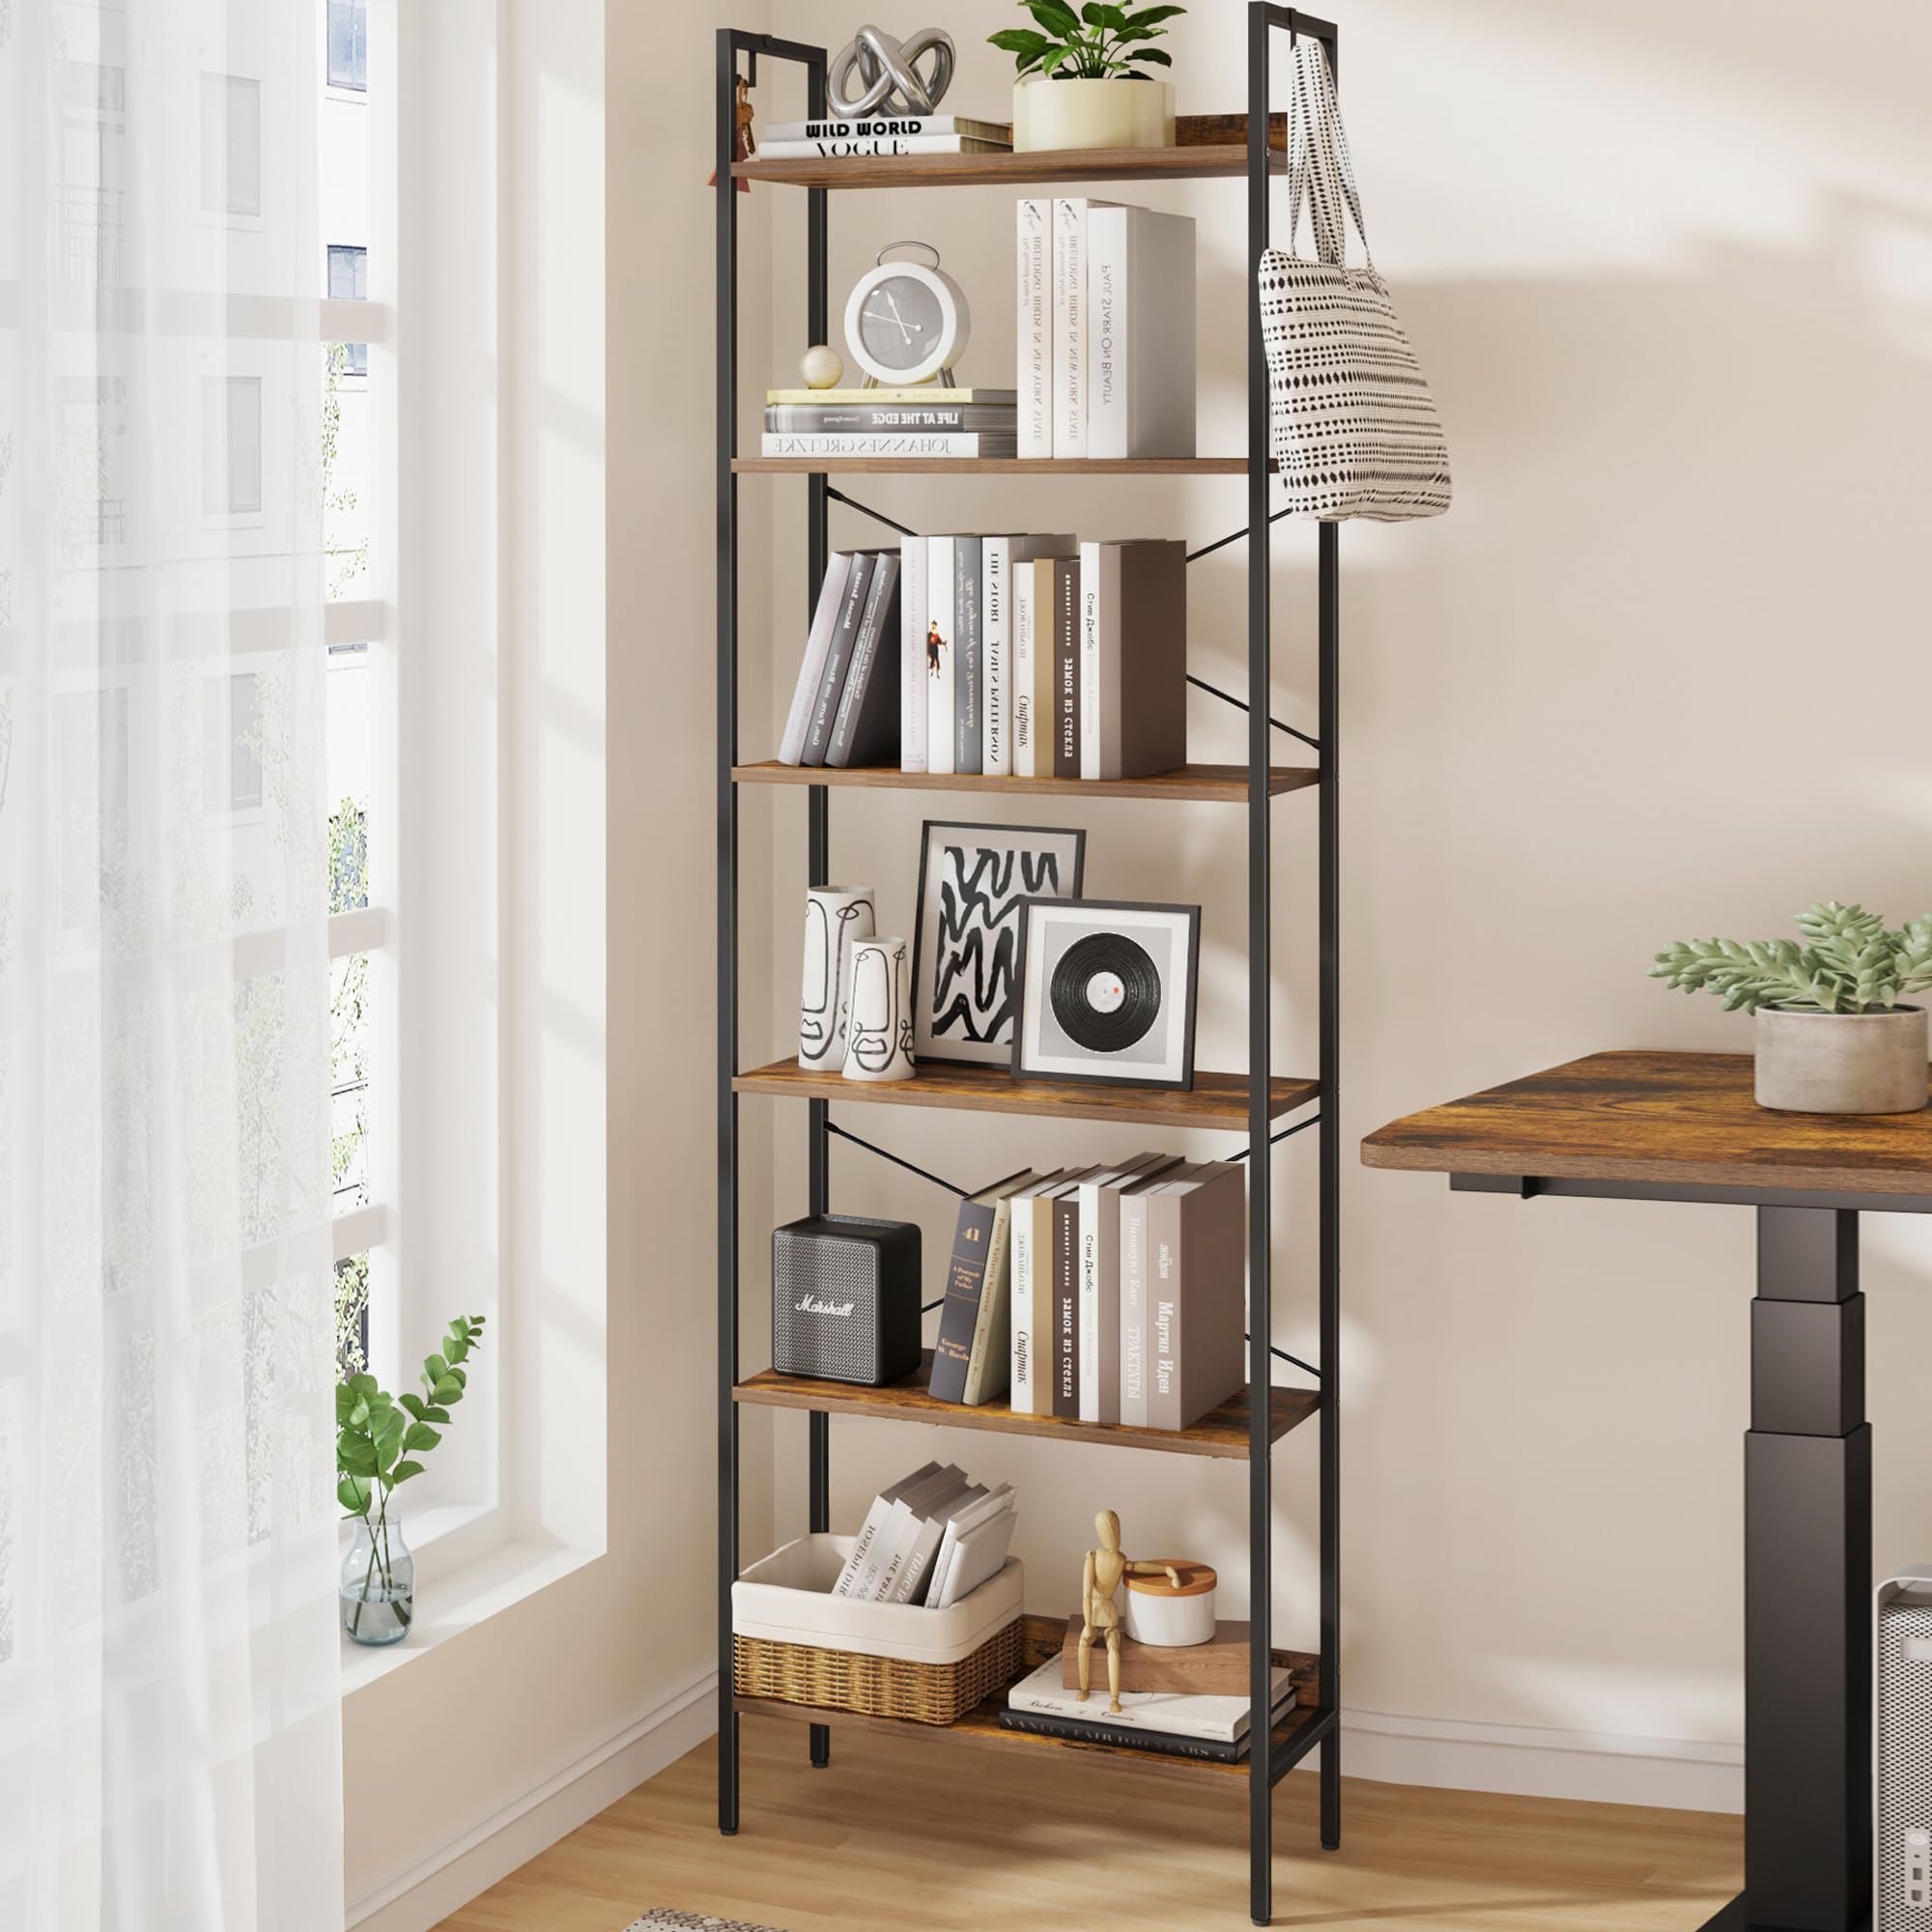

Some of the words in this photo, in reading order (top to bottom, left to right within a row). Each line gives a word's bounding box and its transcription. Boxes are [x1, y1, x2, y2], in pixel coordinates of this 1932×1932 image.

[806, 124, 850, 138] WILD
[857, 121, 922, 137] WORLD
[816, 139, 909, 157] VOGUE
[1087, 592, 1095, 616] Стив
[1086, 618, 1095, 650] Джобс
[1065, 658, 1073, 695] замок
[1015, 695, 1031, 749] Спартак
[1065, 698, 1073, 713] из
[1065, 717, 1073, 757] стекла
[962, 1227, 980, 1242] 41
[1085, 1260, 1094, 1293] Джобс
[795, 1293, 855, 1317] Marshall
[1063, 1297, 1072, 1334] замок
[1155, 1300, 1174, 1354] Мартин
[1014, 1330, 1029, 1385] Спартак
[1063, 1339, 1072, 1353] из
[1128, 1327, 1140, 1400] ТРАКТАТЫ
[1063, 1357, 1072, 1398] стекла
[1156, 1358, 1174, 1395] Иден
